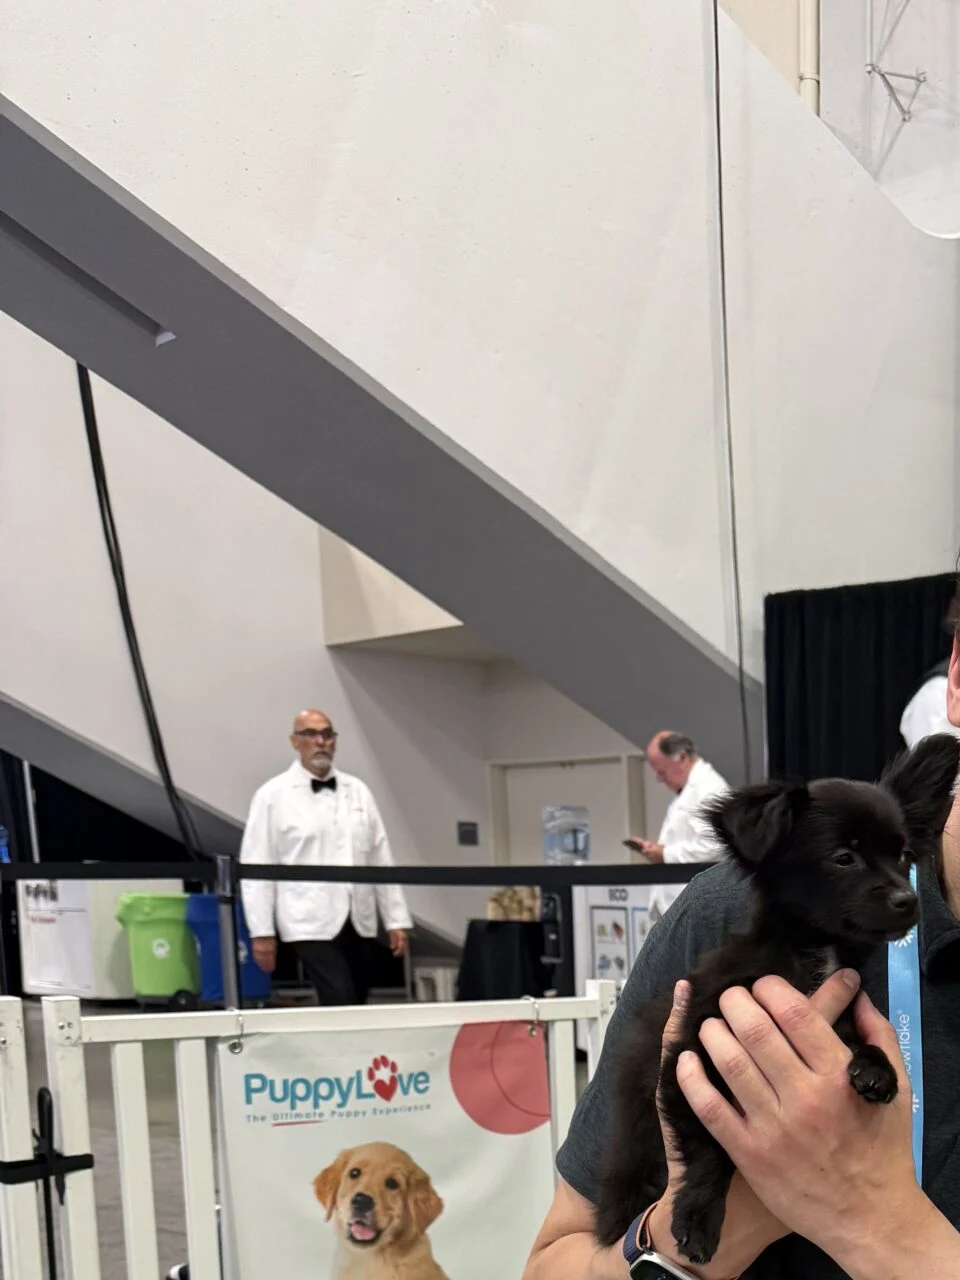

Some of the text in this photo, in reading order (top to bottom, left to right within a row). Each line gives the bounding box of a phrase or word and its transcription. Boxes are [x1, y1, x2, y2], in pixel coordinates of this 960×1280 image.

[246, 1103, 431, 1123] The Ultimate Puppy Experience
